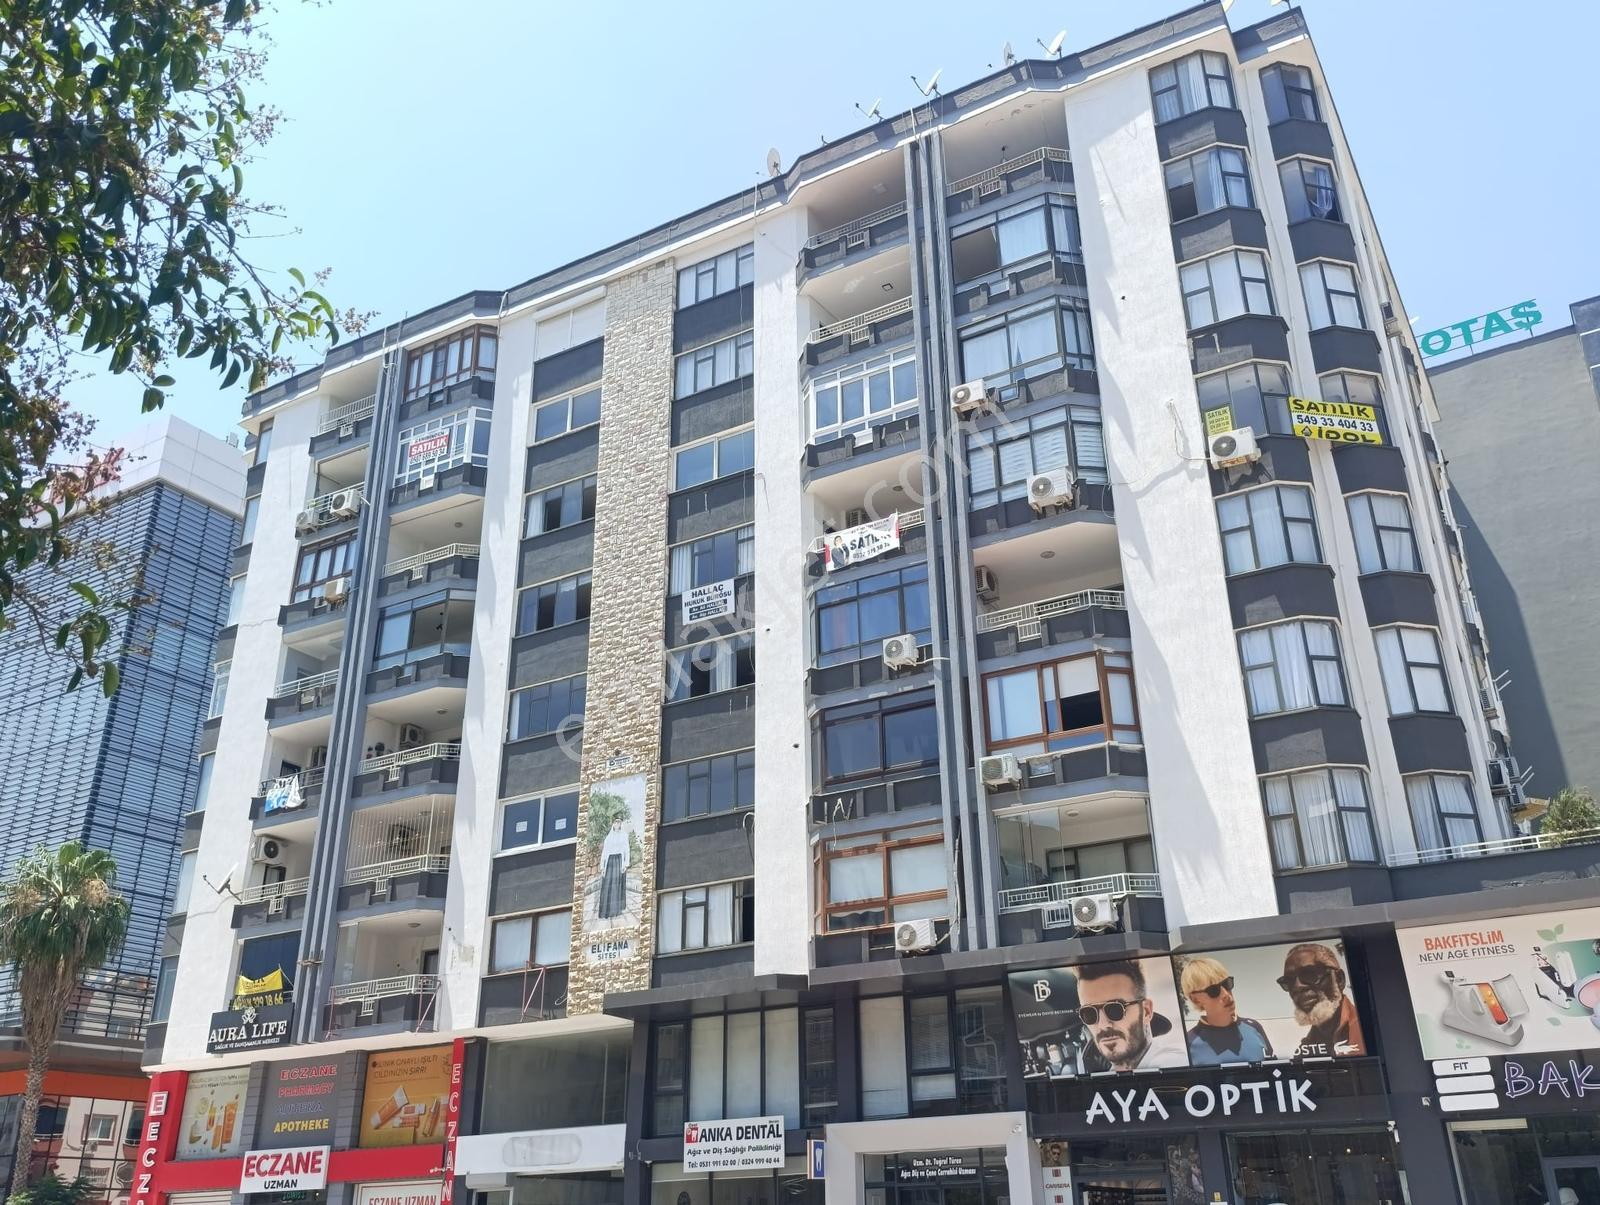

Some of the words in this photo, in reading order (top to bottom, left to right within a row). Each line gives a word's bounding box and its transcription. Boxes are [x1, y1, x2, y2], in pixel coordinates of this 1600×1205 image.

[1293, 399, 1369, 417] SATILIK
[1297, 414, 1318, 425] 549
[1319, 417, 1335, 427] 33
[1337, 419, 1357, 430] 404
[1360, 421, 1374, 432] 33
[411, 437, 447, 455] SATILIK
[692, 585, 723, 598] HALLAÇ
[684, 598, 705, 608] HUKUK
[1419, 952, 1443, 962] NEW
[1447, 949, 1470, 960] AGE
[1472, 944, 1515, 957] FITNESS
[208, 1025, 247, 1044] AURA
[251, 1020, 288, 1038] LIFE
[1263, 1043, 1328, 1058] LOSTE
[280, 1064, 337, 1081] ECZANE
[1453, 1062, 1468, 1070] FIT
[1504, 1059, 1600, 1098] BAK
[278, 1081, 334, 1098] PHARMACY
[1086, 1088, 1169, 1125] AYA
[1184, 1068, 1317, 1117] OPTİK
[274, 1118, 329, 1134] APOTHEKE
[700, 1127, 733, 1142] ANKA
[736, 1123, 782, 1141] DENTAL
[687, 1149, 702, 1157] Ağız
[713, 1146, 722, 1155] Diş
[136, 1121, 161, 1205] ECZ
[245, 1151, 323, 1178] ECZANE
[699, 1160, 711, 1168] 0531
[263, 1180, 298, 1190] UZMAN
